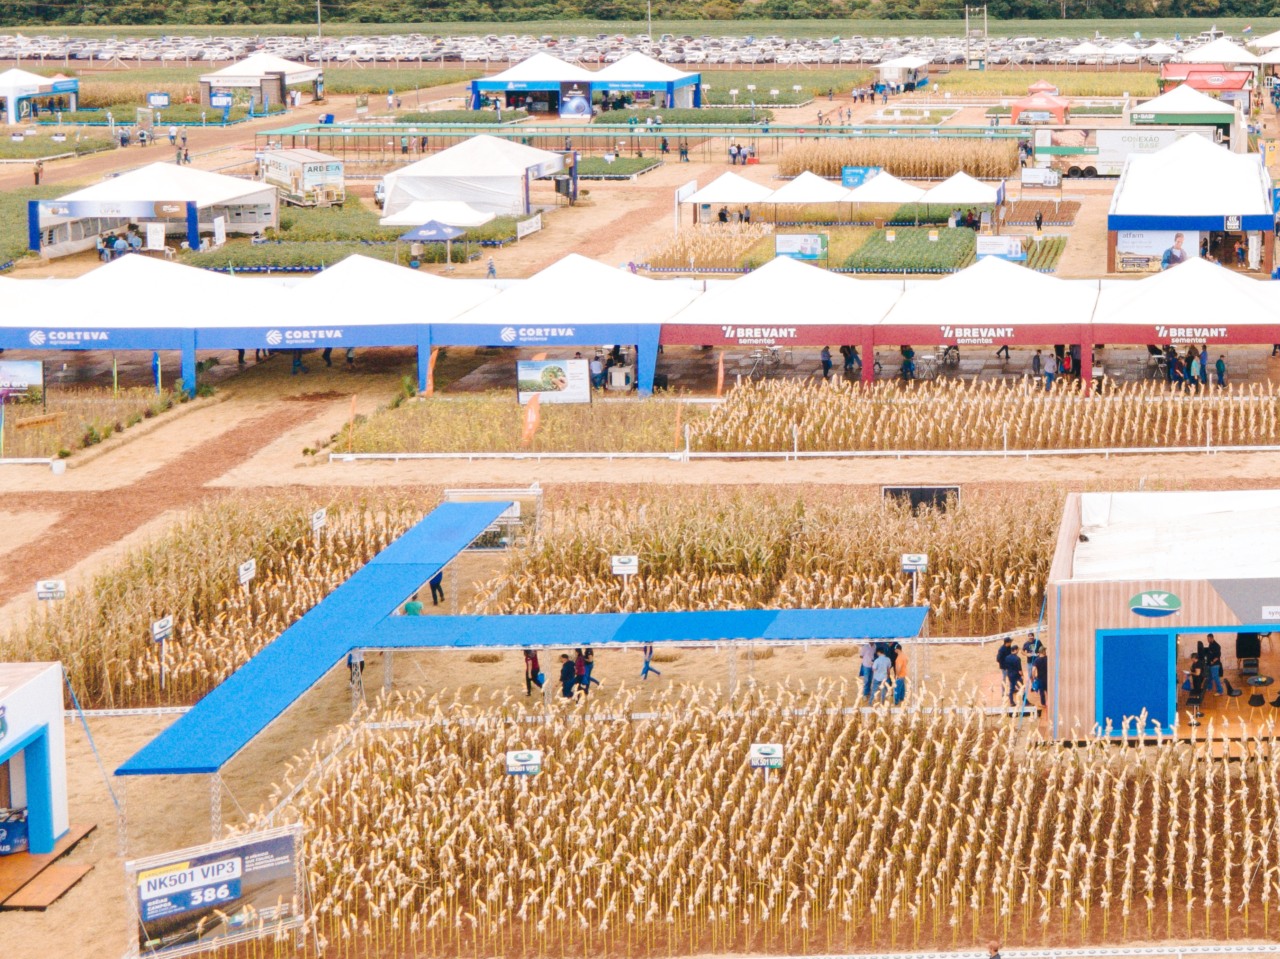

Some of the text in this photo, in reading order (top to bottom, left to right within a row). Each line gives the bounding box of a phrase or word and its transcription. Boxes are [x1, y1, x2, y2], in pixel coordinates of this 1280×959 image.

[738, 337, 776, 345] sementes
[956, 337, 993, 345] sementes
[1170, 337, 1207, 345] sementes
[1142, 594, 1169, 607] NK
[147, 861, 236, 892] NK501 VIP3
[190, 884, 231, 906] 386
